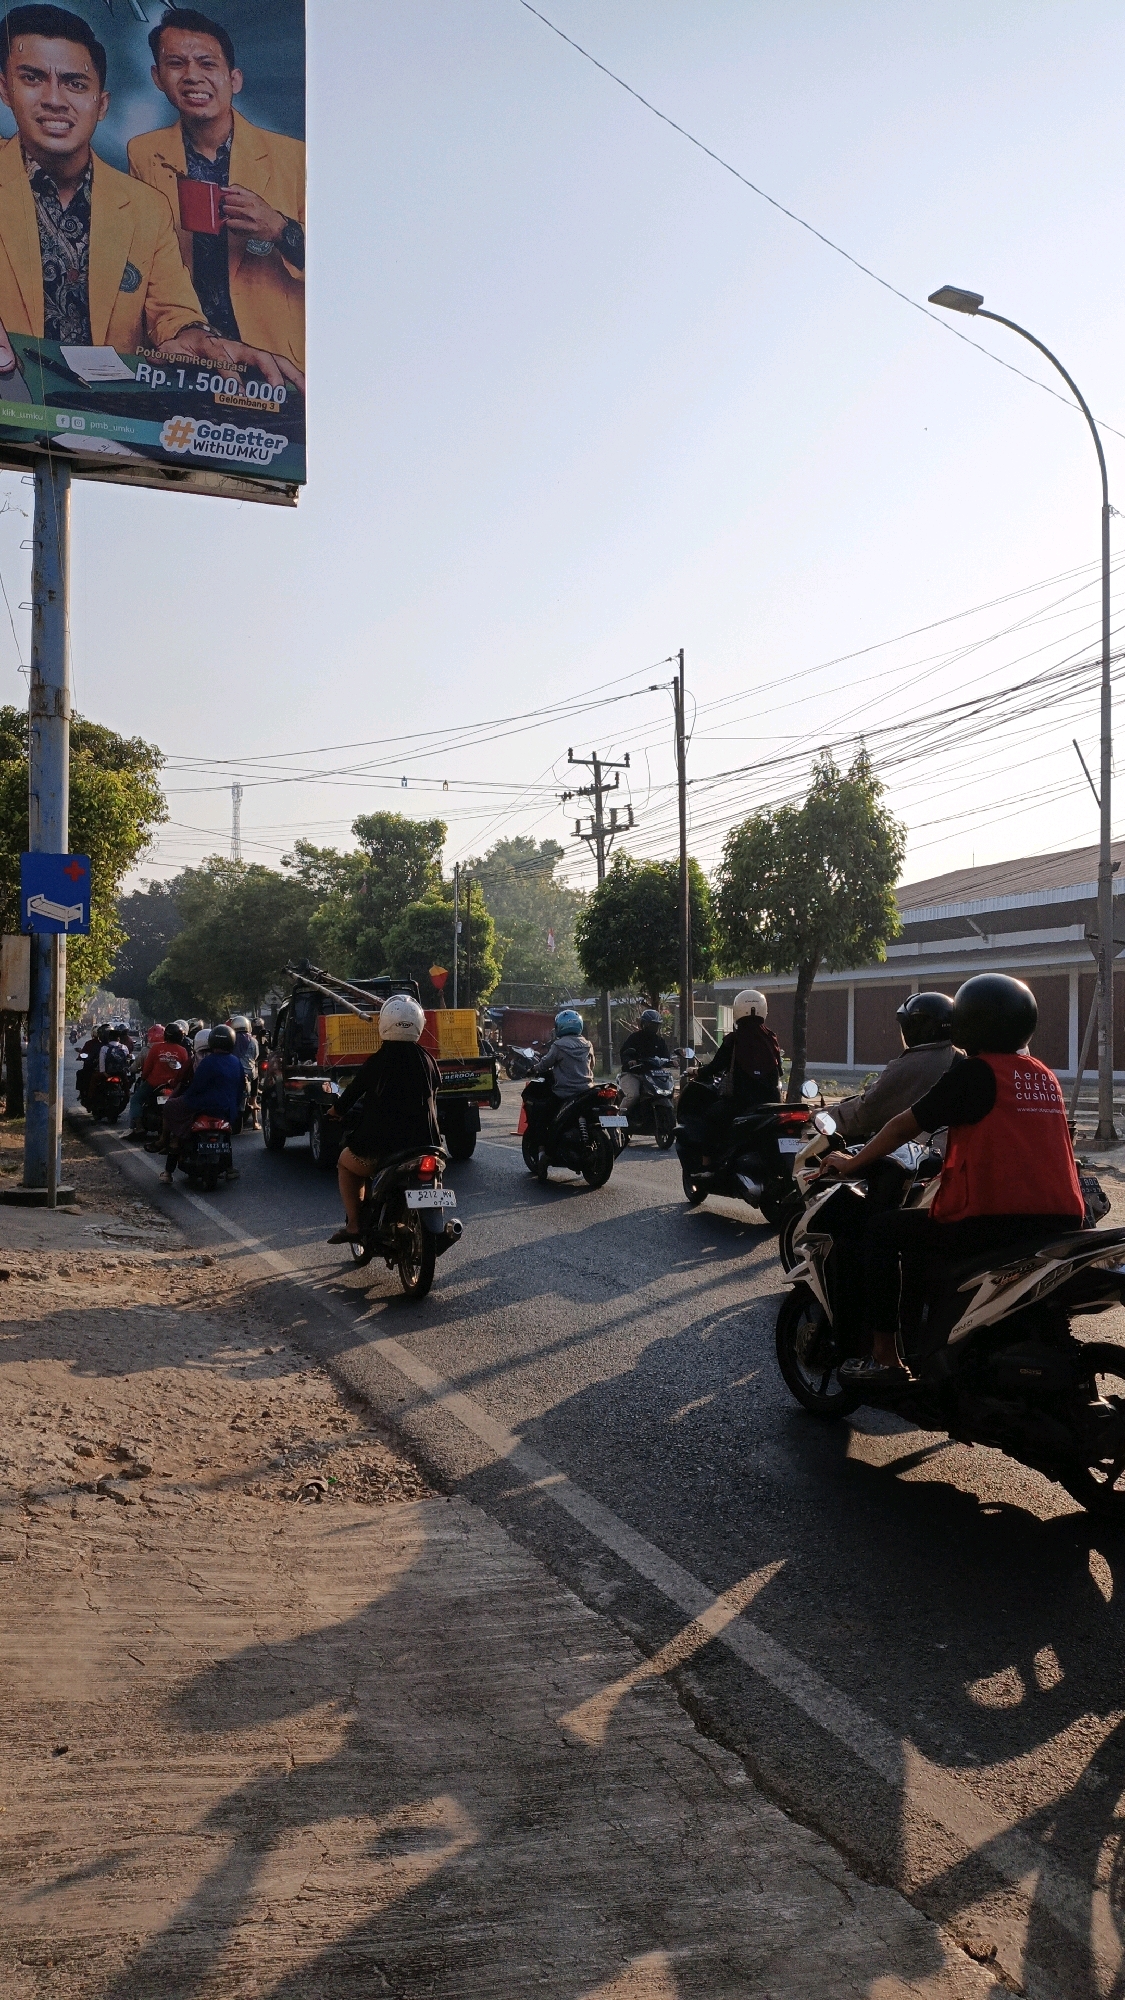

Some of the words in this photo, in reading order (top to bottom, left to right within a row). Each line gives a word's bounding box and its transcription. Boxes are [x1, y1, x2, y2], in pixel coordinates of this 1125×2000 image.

[135, 345, 192, 363] Potongan
[192, 356, 248, 373] Registrasi
[135, 363, 287, 404] Rp.1.500.000
[218, 394, 267, 410] Gelombang
[268, 402, 276, 410] 3
[89, 420, 135, 434] pmb_umku
[193, 438, 269, 461] WithUMKU
[407, 1191, 413, 1199] K
[418, 1190, 438, 1199] 5212
